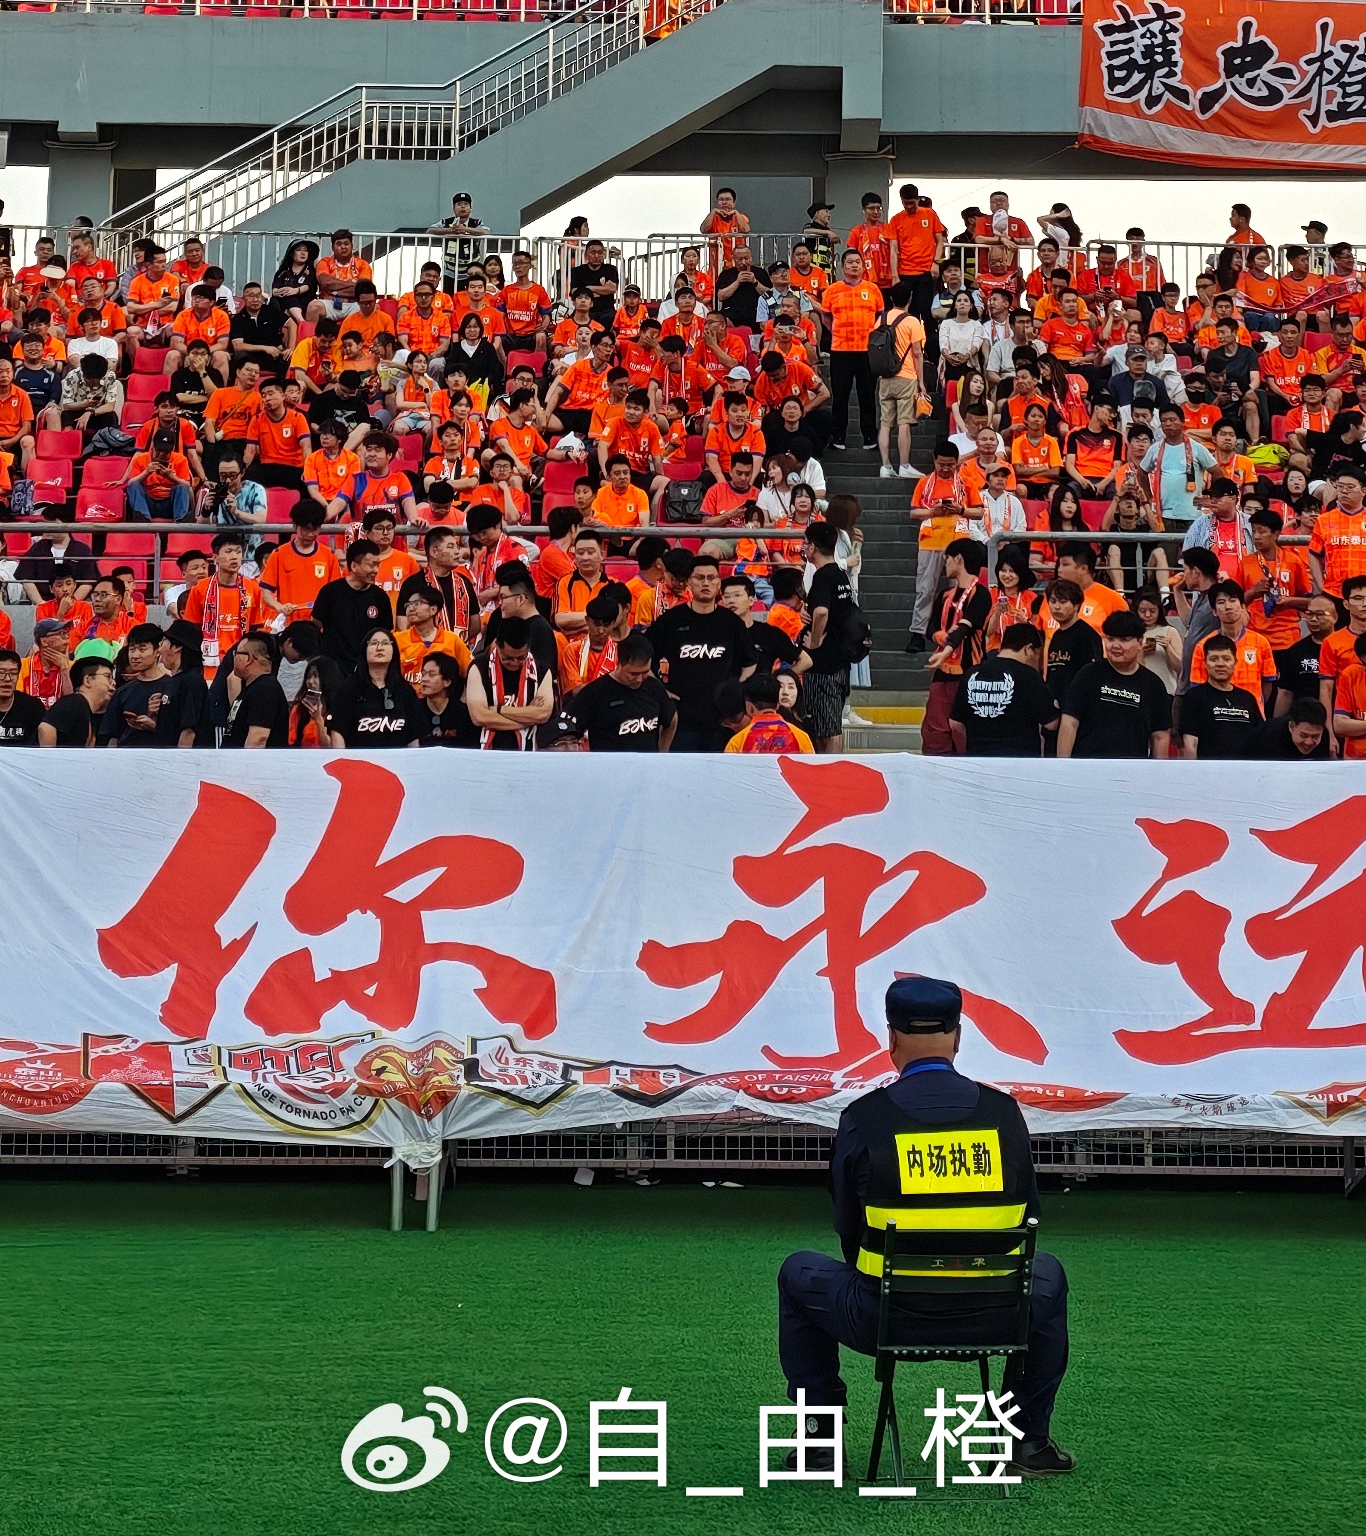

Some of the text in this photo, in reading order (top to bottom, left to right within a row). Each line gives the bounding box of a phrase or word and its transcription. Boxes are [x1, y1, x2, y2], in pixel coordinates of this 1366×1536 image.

[1100, 685, 1141, 704] shandong
[745, 1073, 768, 1083] OF
[278, 1098, 338, 1122] TORNADO
[905, 1142, 992, 1179] 内场执勤
